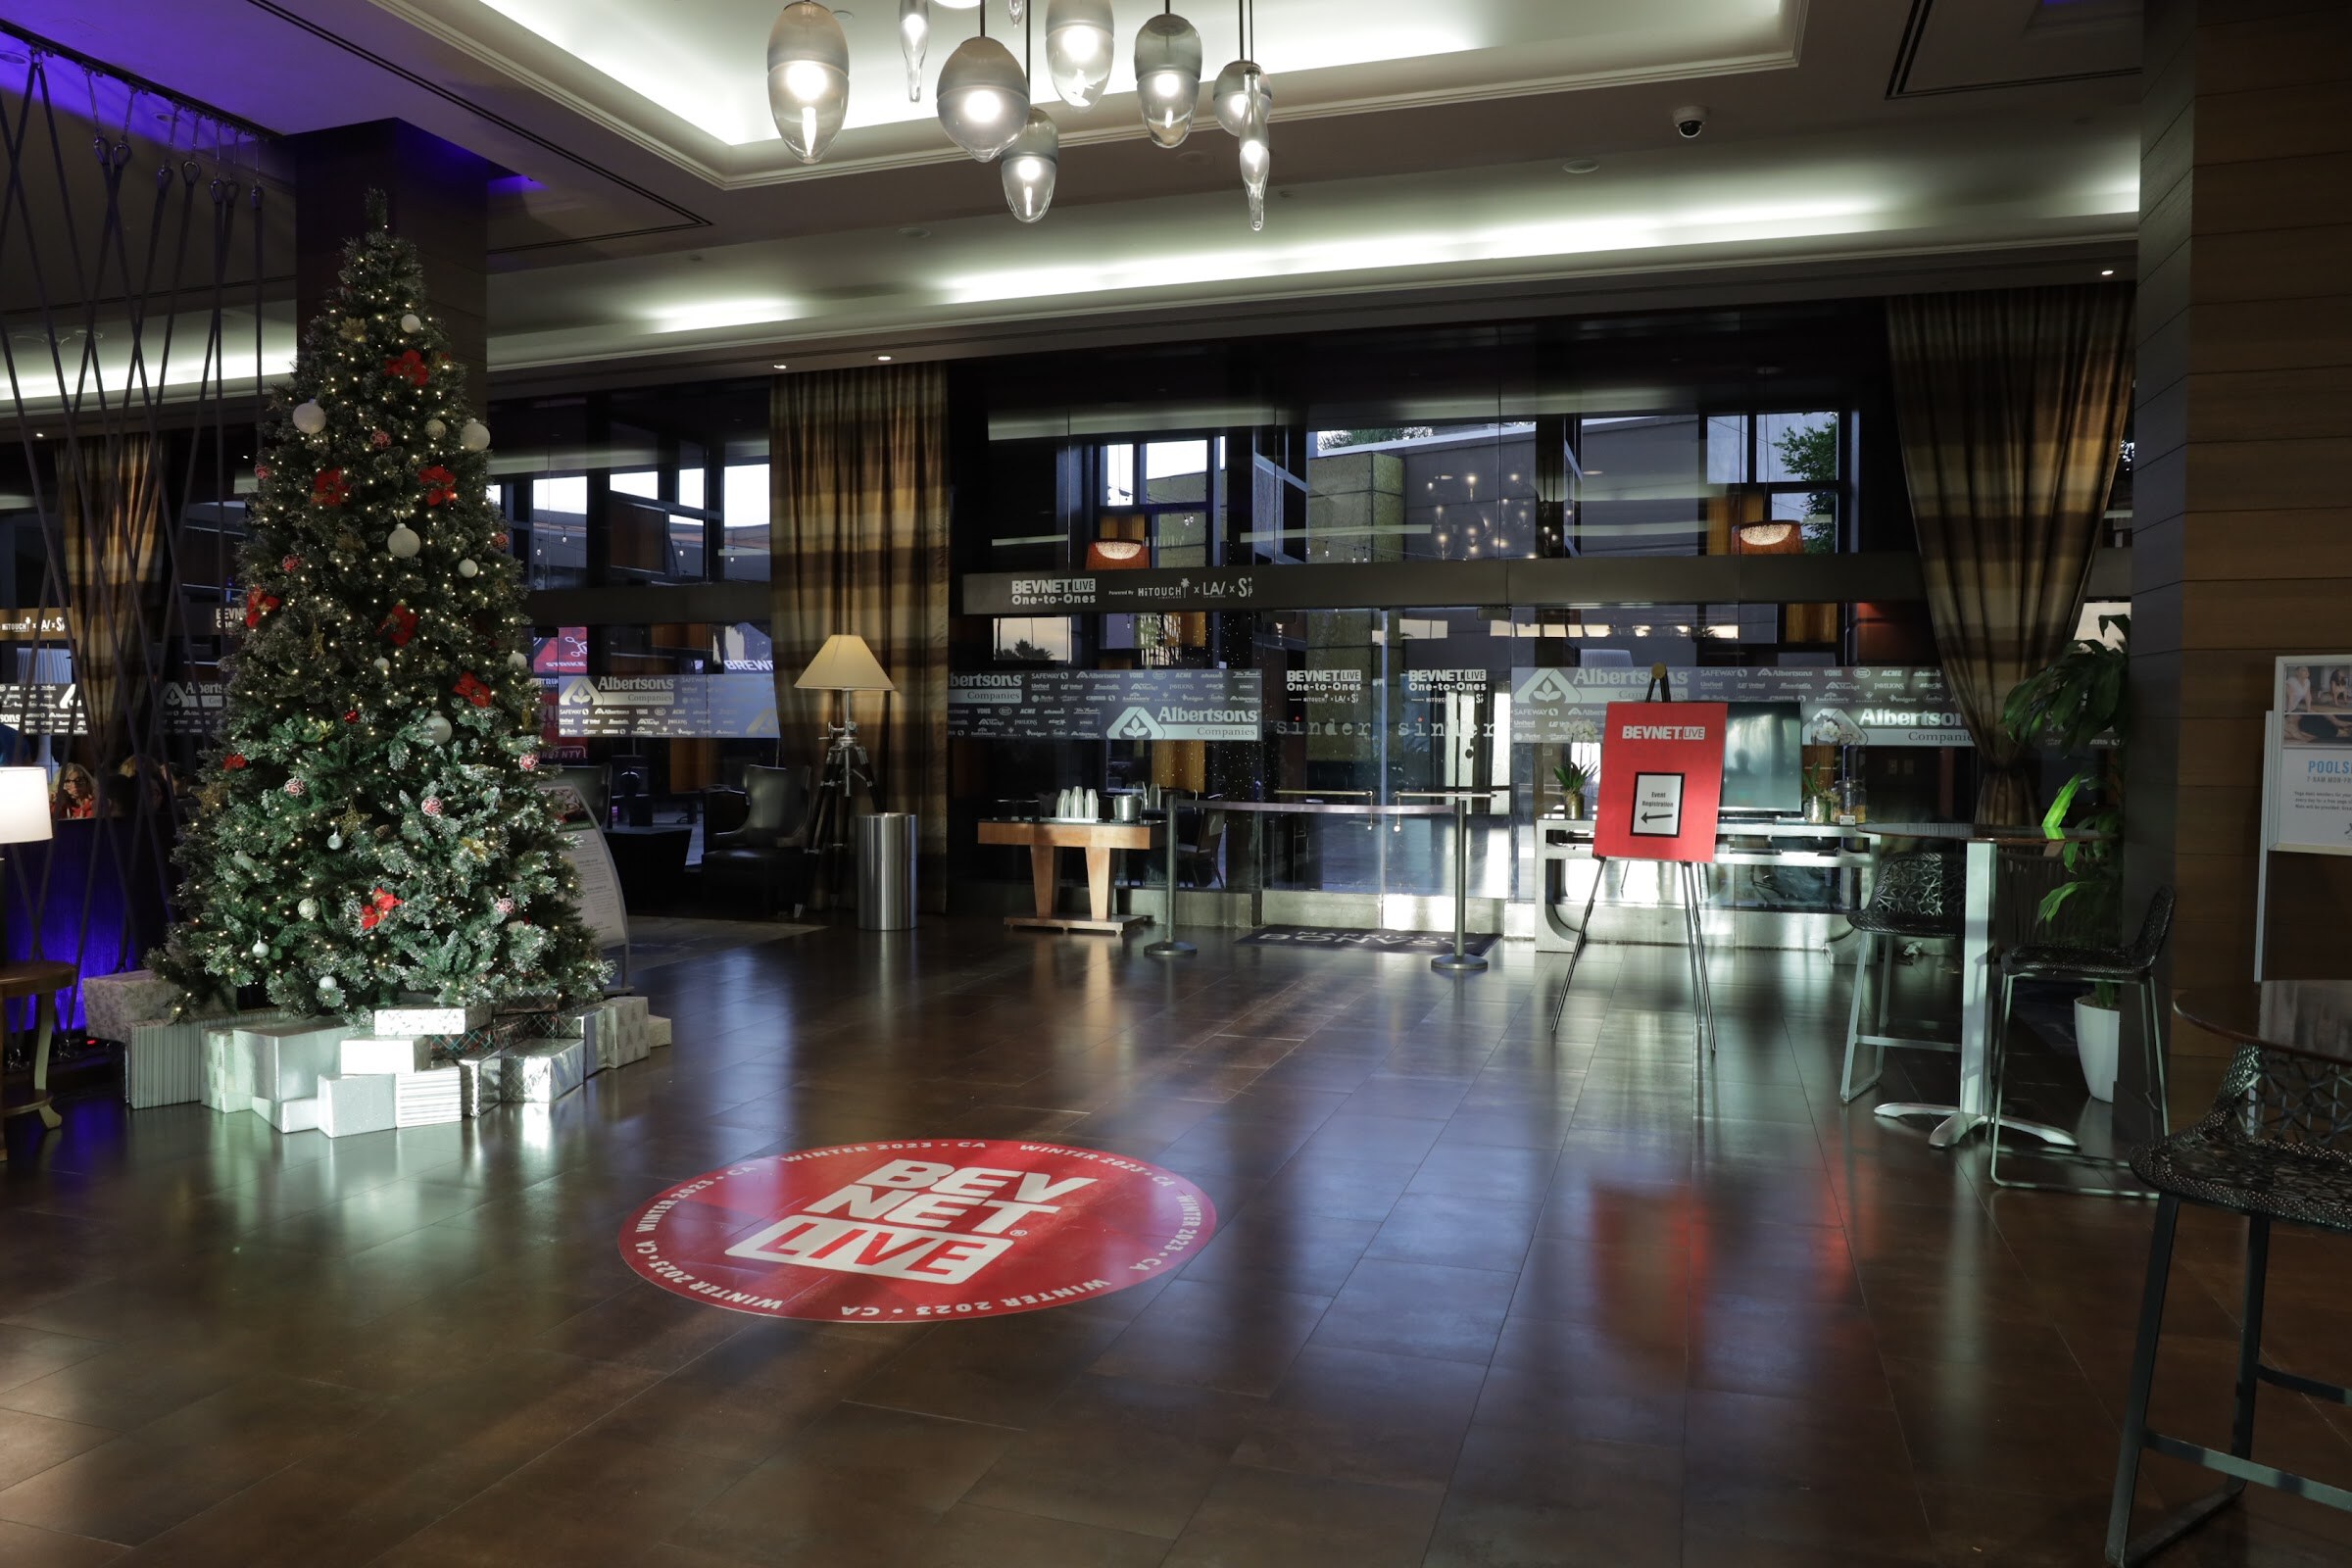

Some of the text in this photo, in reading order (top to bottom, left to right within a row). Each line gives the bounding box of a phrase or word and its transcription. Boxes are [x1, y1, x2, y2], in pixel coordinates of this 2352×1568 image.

[1011, 579, 1095, 595] BEVNET LIVE
[1138, 587, 1182, 597] HiTOUCH
[1011, 594, 1096, 606] One-to-Ones
[597, 676, 674, 691] Albertsons
[949, 672, 1023, 688] bertsons
[1287, 670, 1360, 682] BEVNET LIVE
[1408, 669, 1487, 682] BEVNET LIVE
[1287, 683, 1362, 692] One-to-Ones
[1408, 682, 1487, 692] One-to-Ones
[628, 694, 673, 704] Companies
[967, 690, 1022, 703] Companies
[1157, 707, 1258, 723] Albertsons
[1858, 708, 1963, 727] Albertso
[1197, 727, 1256, 740] Companies
[1621, 725, 1704, 741] BEVNET LIVE
[1908, 731, 1973, 746] Companie
[2308, 760, 2352, 774] POOLS
[1642, 800, 1674, 808] Registration
[780, 1145, 869, 1163] WINTER
[877, 1142, 932, 1151] 2023
[1018, 1144, 1176, 1188] WINTER 2023 CA
[855, 1158, 1099, 1204] BEV
[634, 1165, 758, 1233] WINTER 2023 CA
[802, 1183, 1063, 1236] NET
[1129, 1194, 1202, 1272] WINTER 2023 CA
[755, 1221, 987, 1277] LIVE
[634, 1239, 784, 1310] WINTER 2023 CA
[841, 1278, 1112, 1317] WINTER 2023 CA
